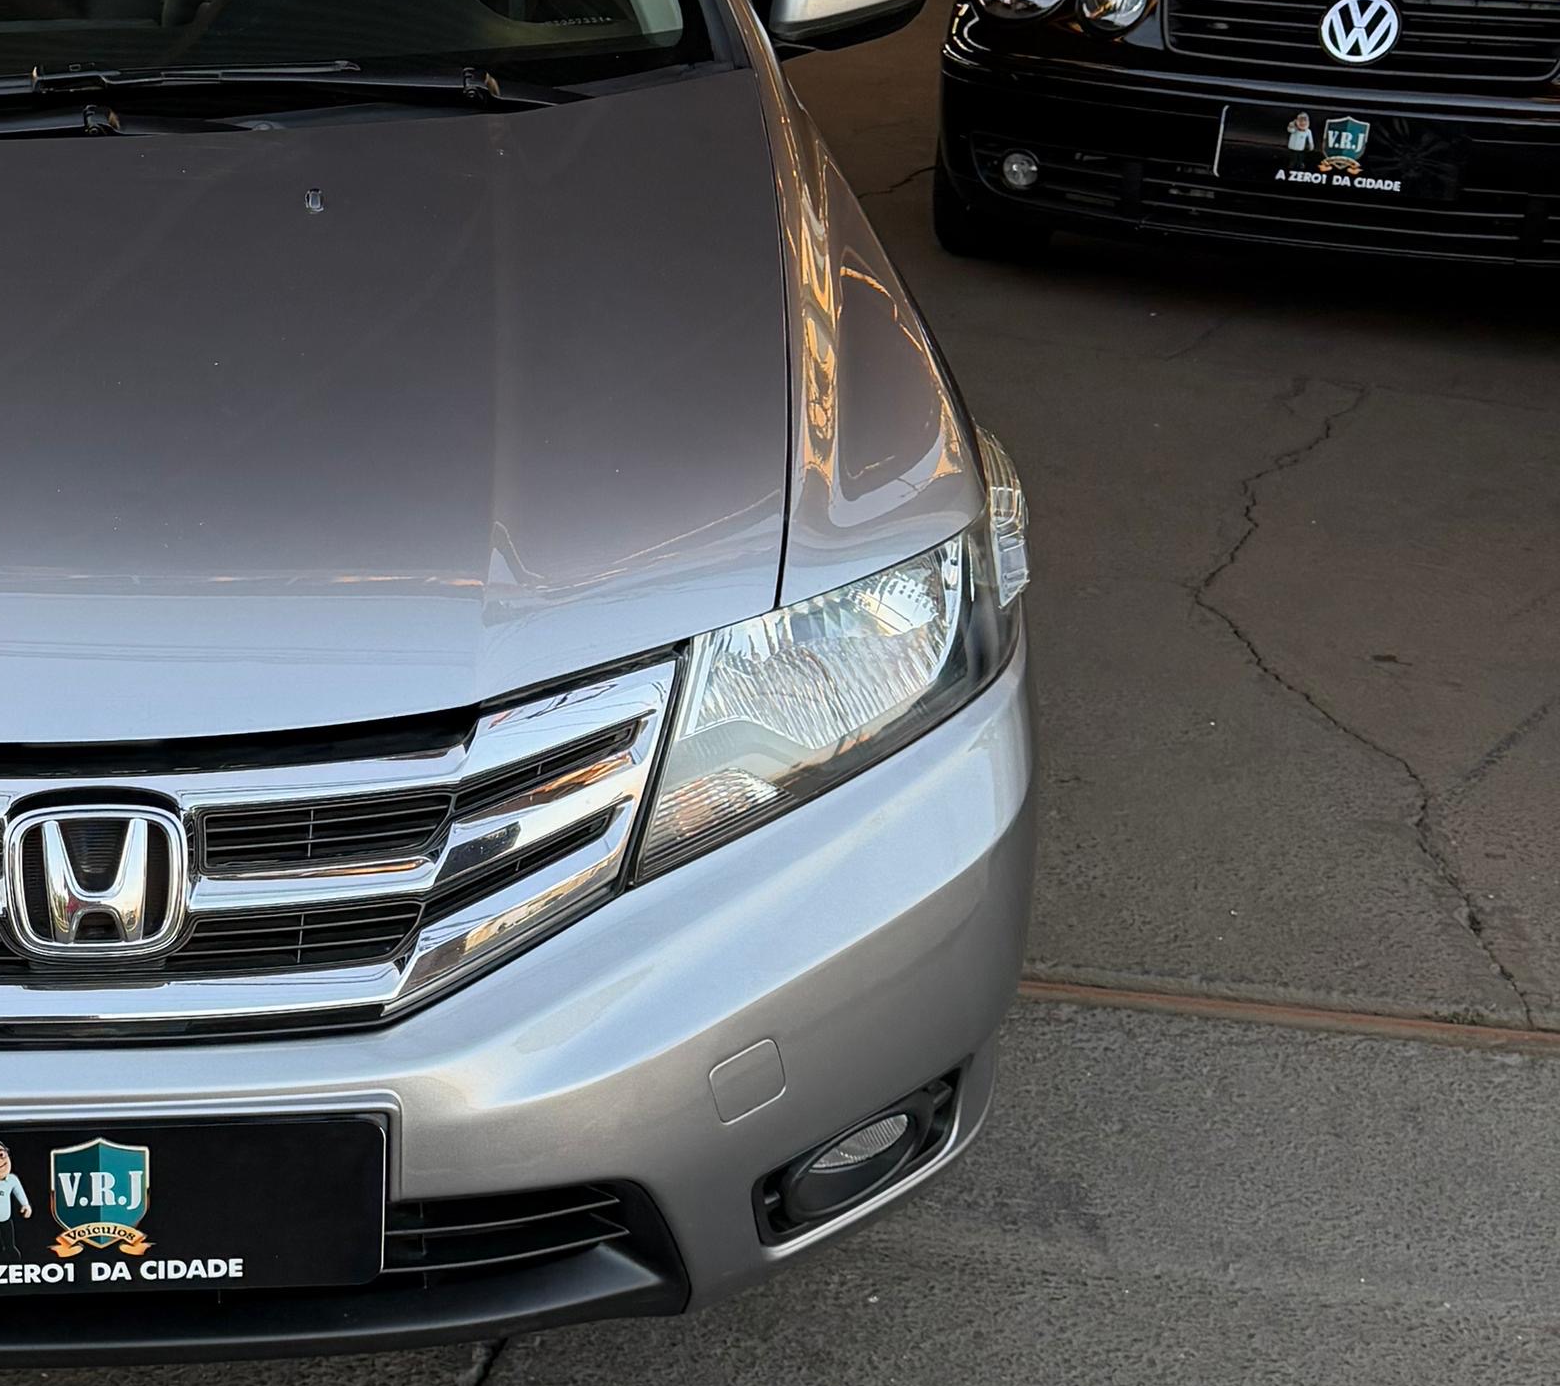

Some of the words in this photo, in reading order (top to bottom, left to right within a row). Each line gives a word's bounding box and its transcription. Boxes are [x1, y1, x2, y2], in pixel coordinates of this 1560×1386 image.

[1327, 129, 1365, 153] V.R.J
[1275, 169, 1286, 180] A
[1332, 175, 1351, 187] DA
[1354, 177, 1402, 192] CIDADE
[57, 1169, 144, 1211] V.R.J
[65, 1225, 136, 1241] Veículos
[91, 1260, 132, 1283] DA
[140, 1258, 244, 1281] CIDADE
